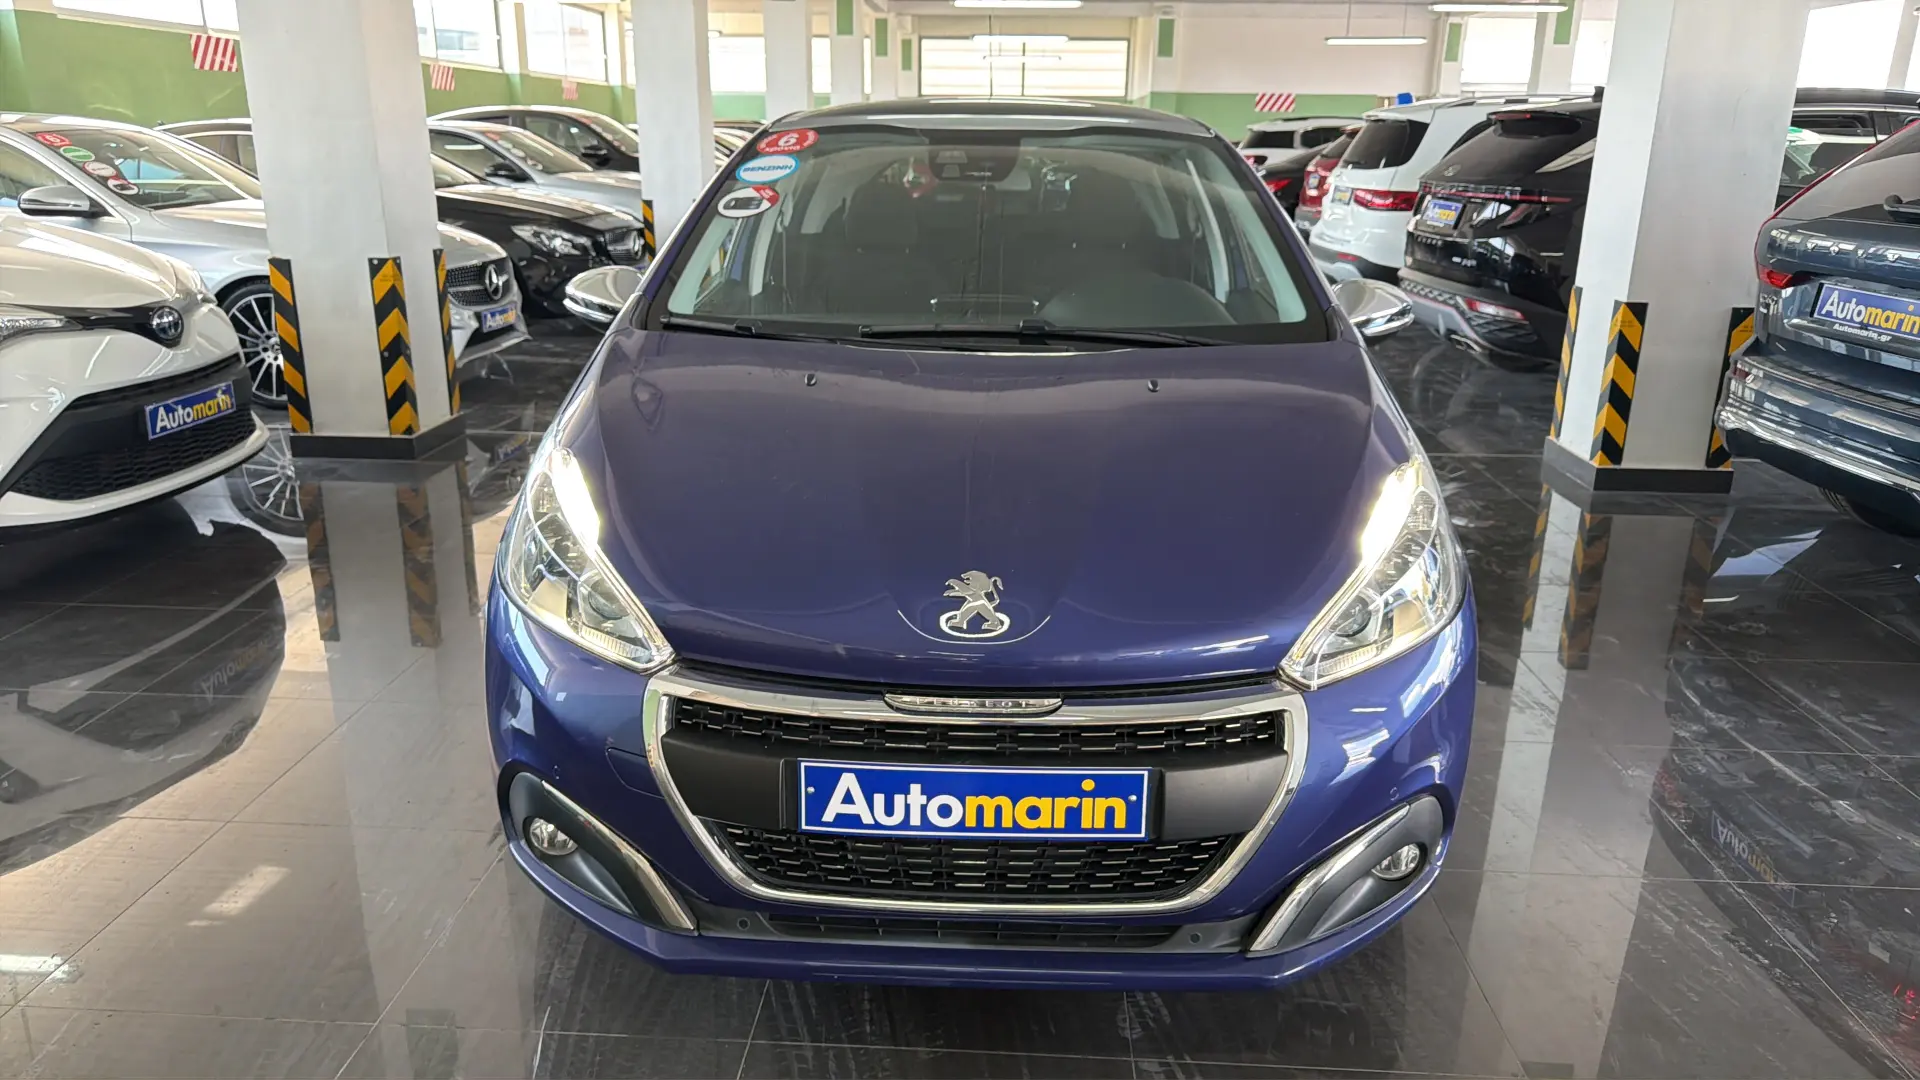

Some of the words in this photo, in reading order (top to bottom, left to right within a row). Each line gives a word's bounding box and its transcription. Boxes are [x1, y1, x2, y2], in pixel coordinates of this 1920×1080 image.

[778, 132, 799, 147] 6
[1833, 323, 1892, 342] Automarin.gr
[156, 388, 232, 433] Automarin
[821, 772, 1126, 829] Automarin
